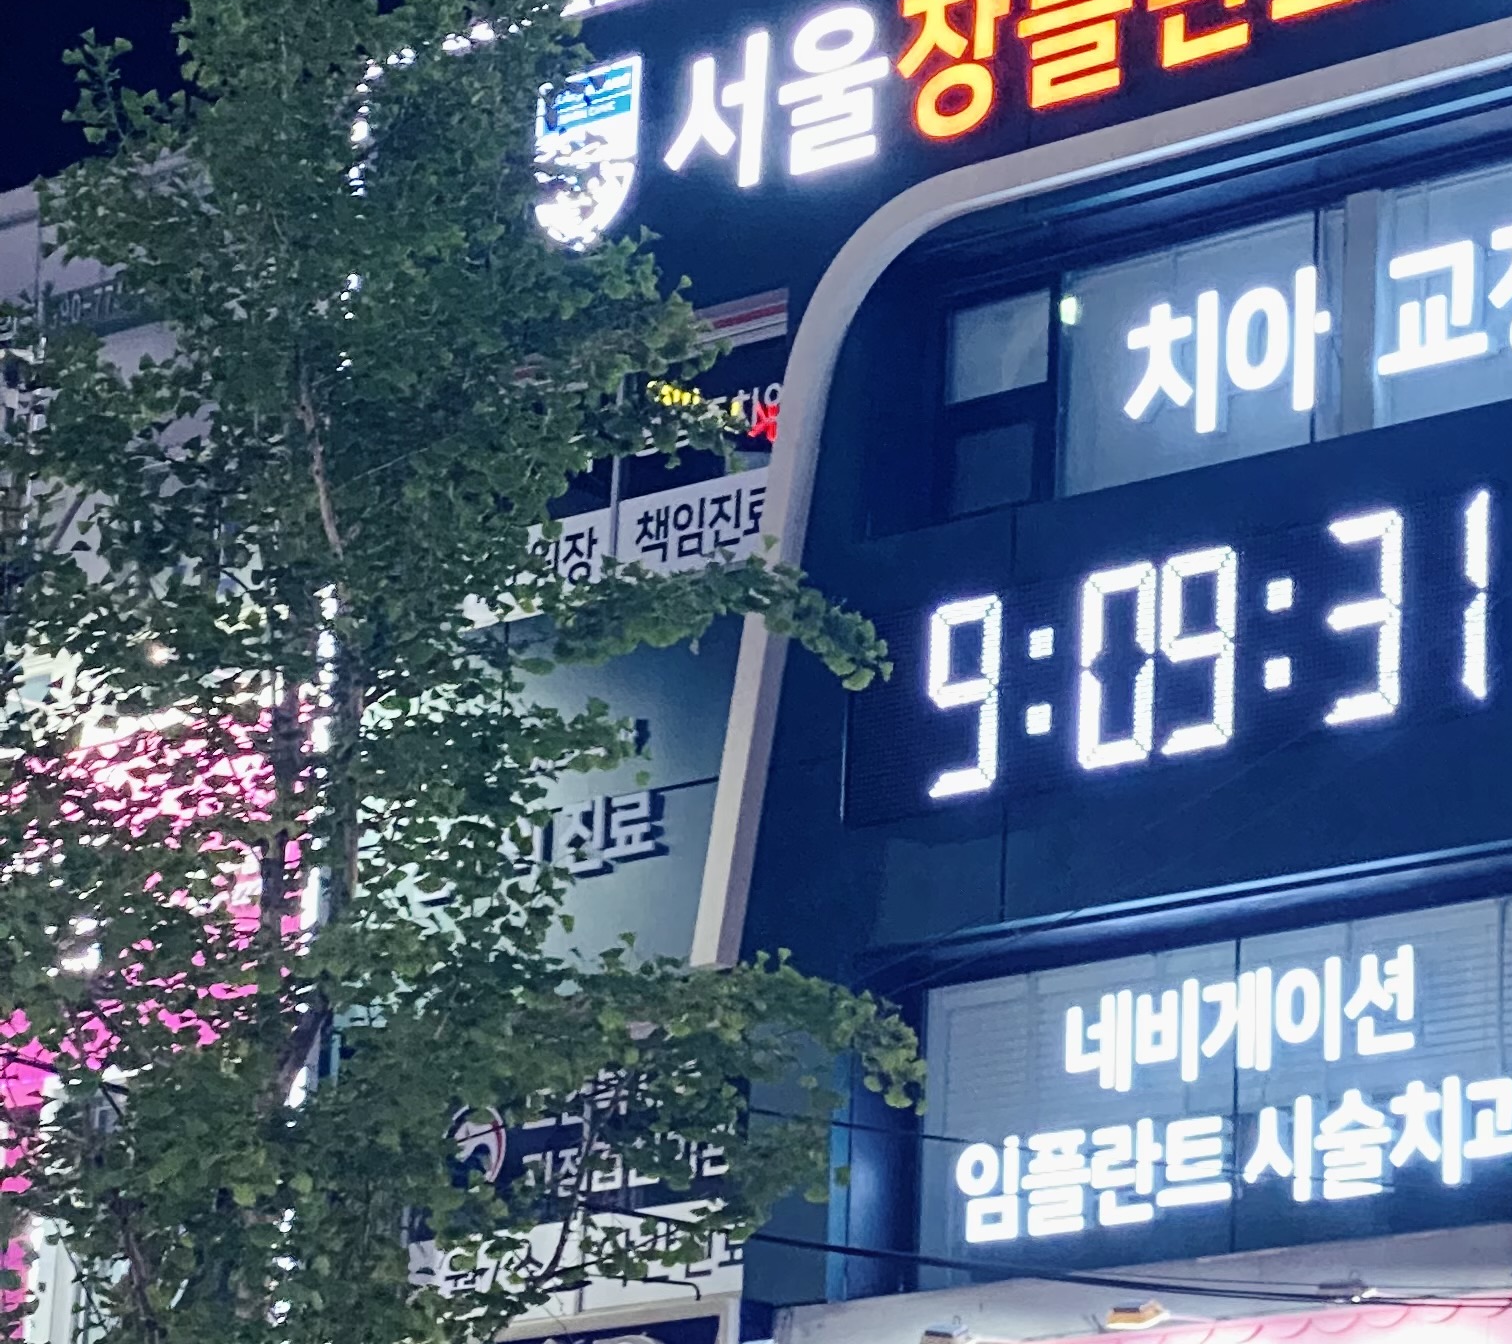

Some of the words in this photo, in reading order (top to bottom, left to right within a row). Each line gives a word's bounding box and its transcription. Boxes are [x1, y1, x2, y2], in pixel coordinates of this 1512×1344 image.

[1123, 265, 1331, 433] 치아
[928, 488, 1491, 799] 9:09:31
[1065, 943, 1415, 1093] 네비게이션
[955, 1116, 1233, 1244] 임플란트
